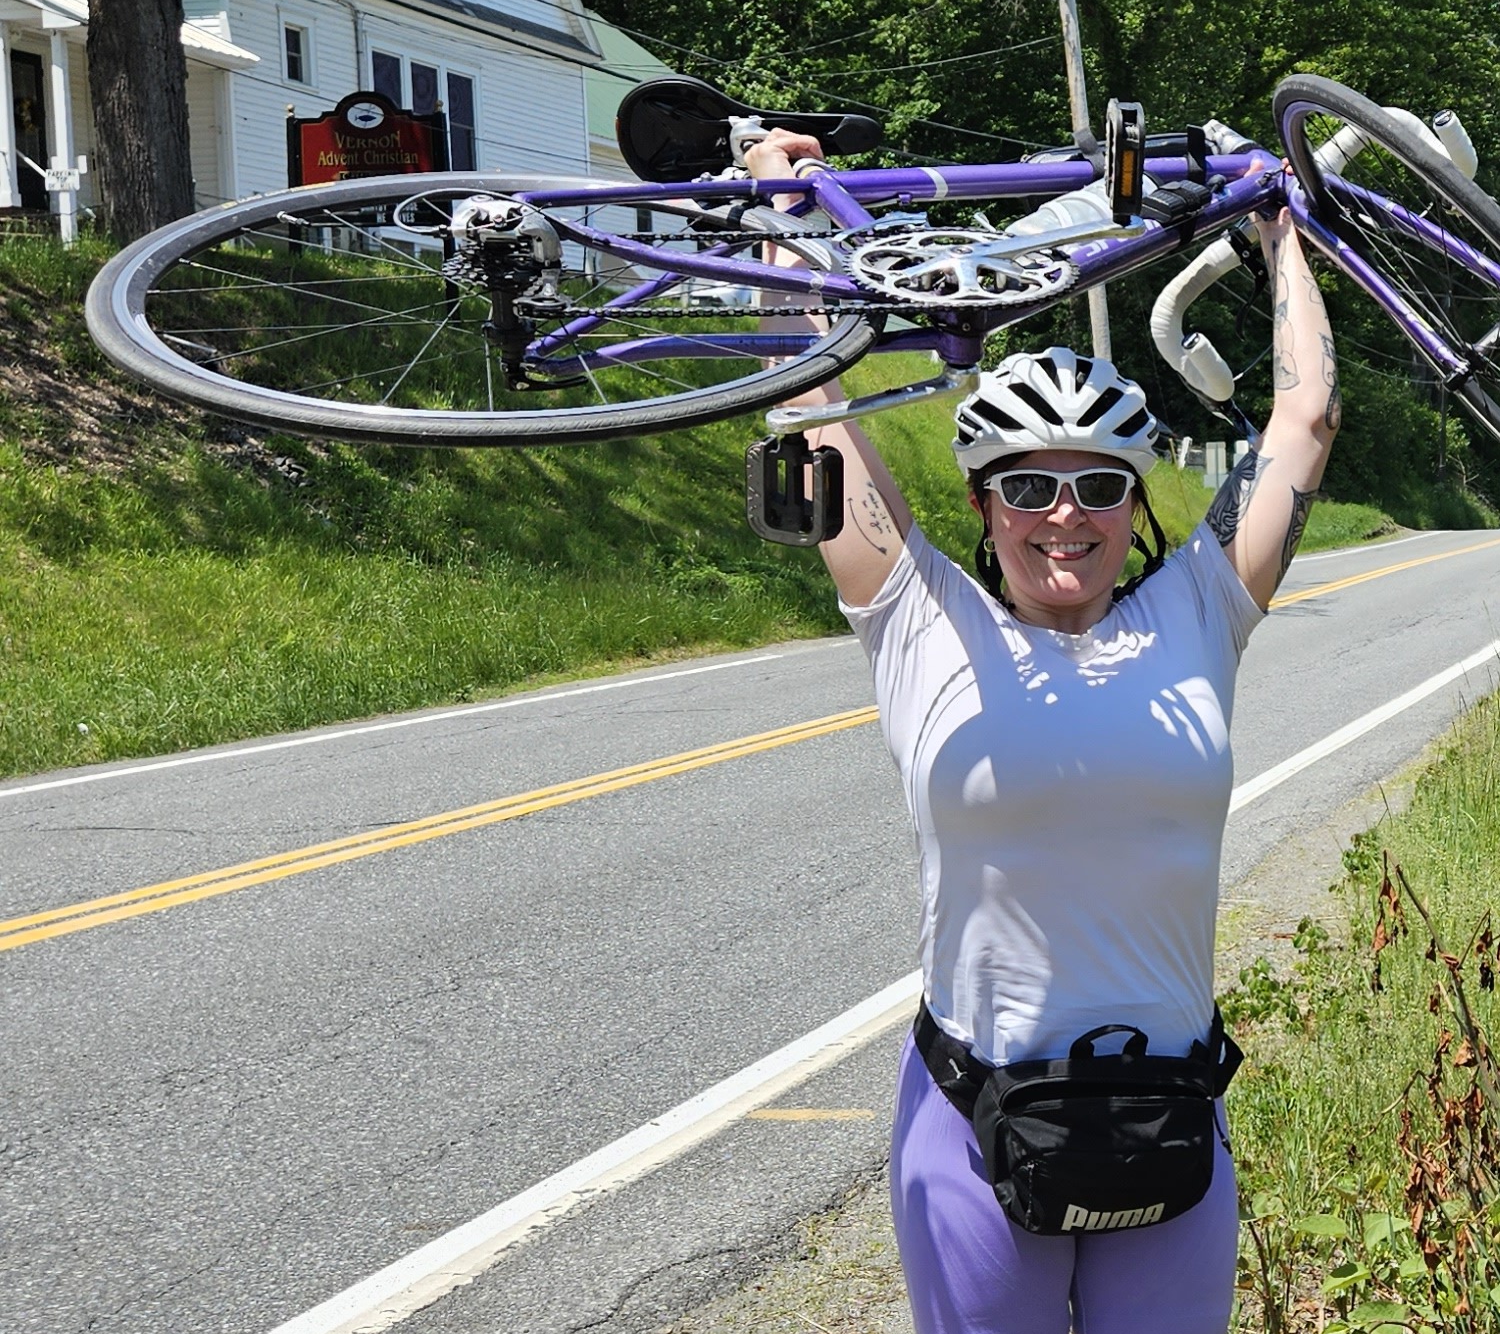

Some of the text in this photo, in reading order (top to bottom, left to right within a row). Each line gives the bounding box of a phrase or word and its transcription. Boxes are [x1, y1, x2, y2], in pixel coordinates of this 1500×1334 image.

[334, 130, 401, 149] VERNON
[317, 150, 419, 166] Advent Christian
[1061, 1202, 1165, 1232] PUMA
